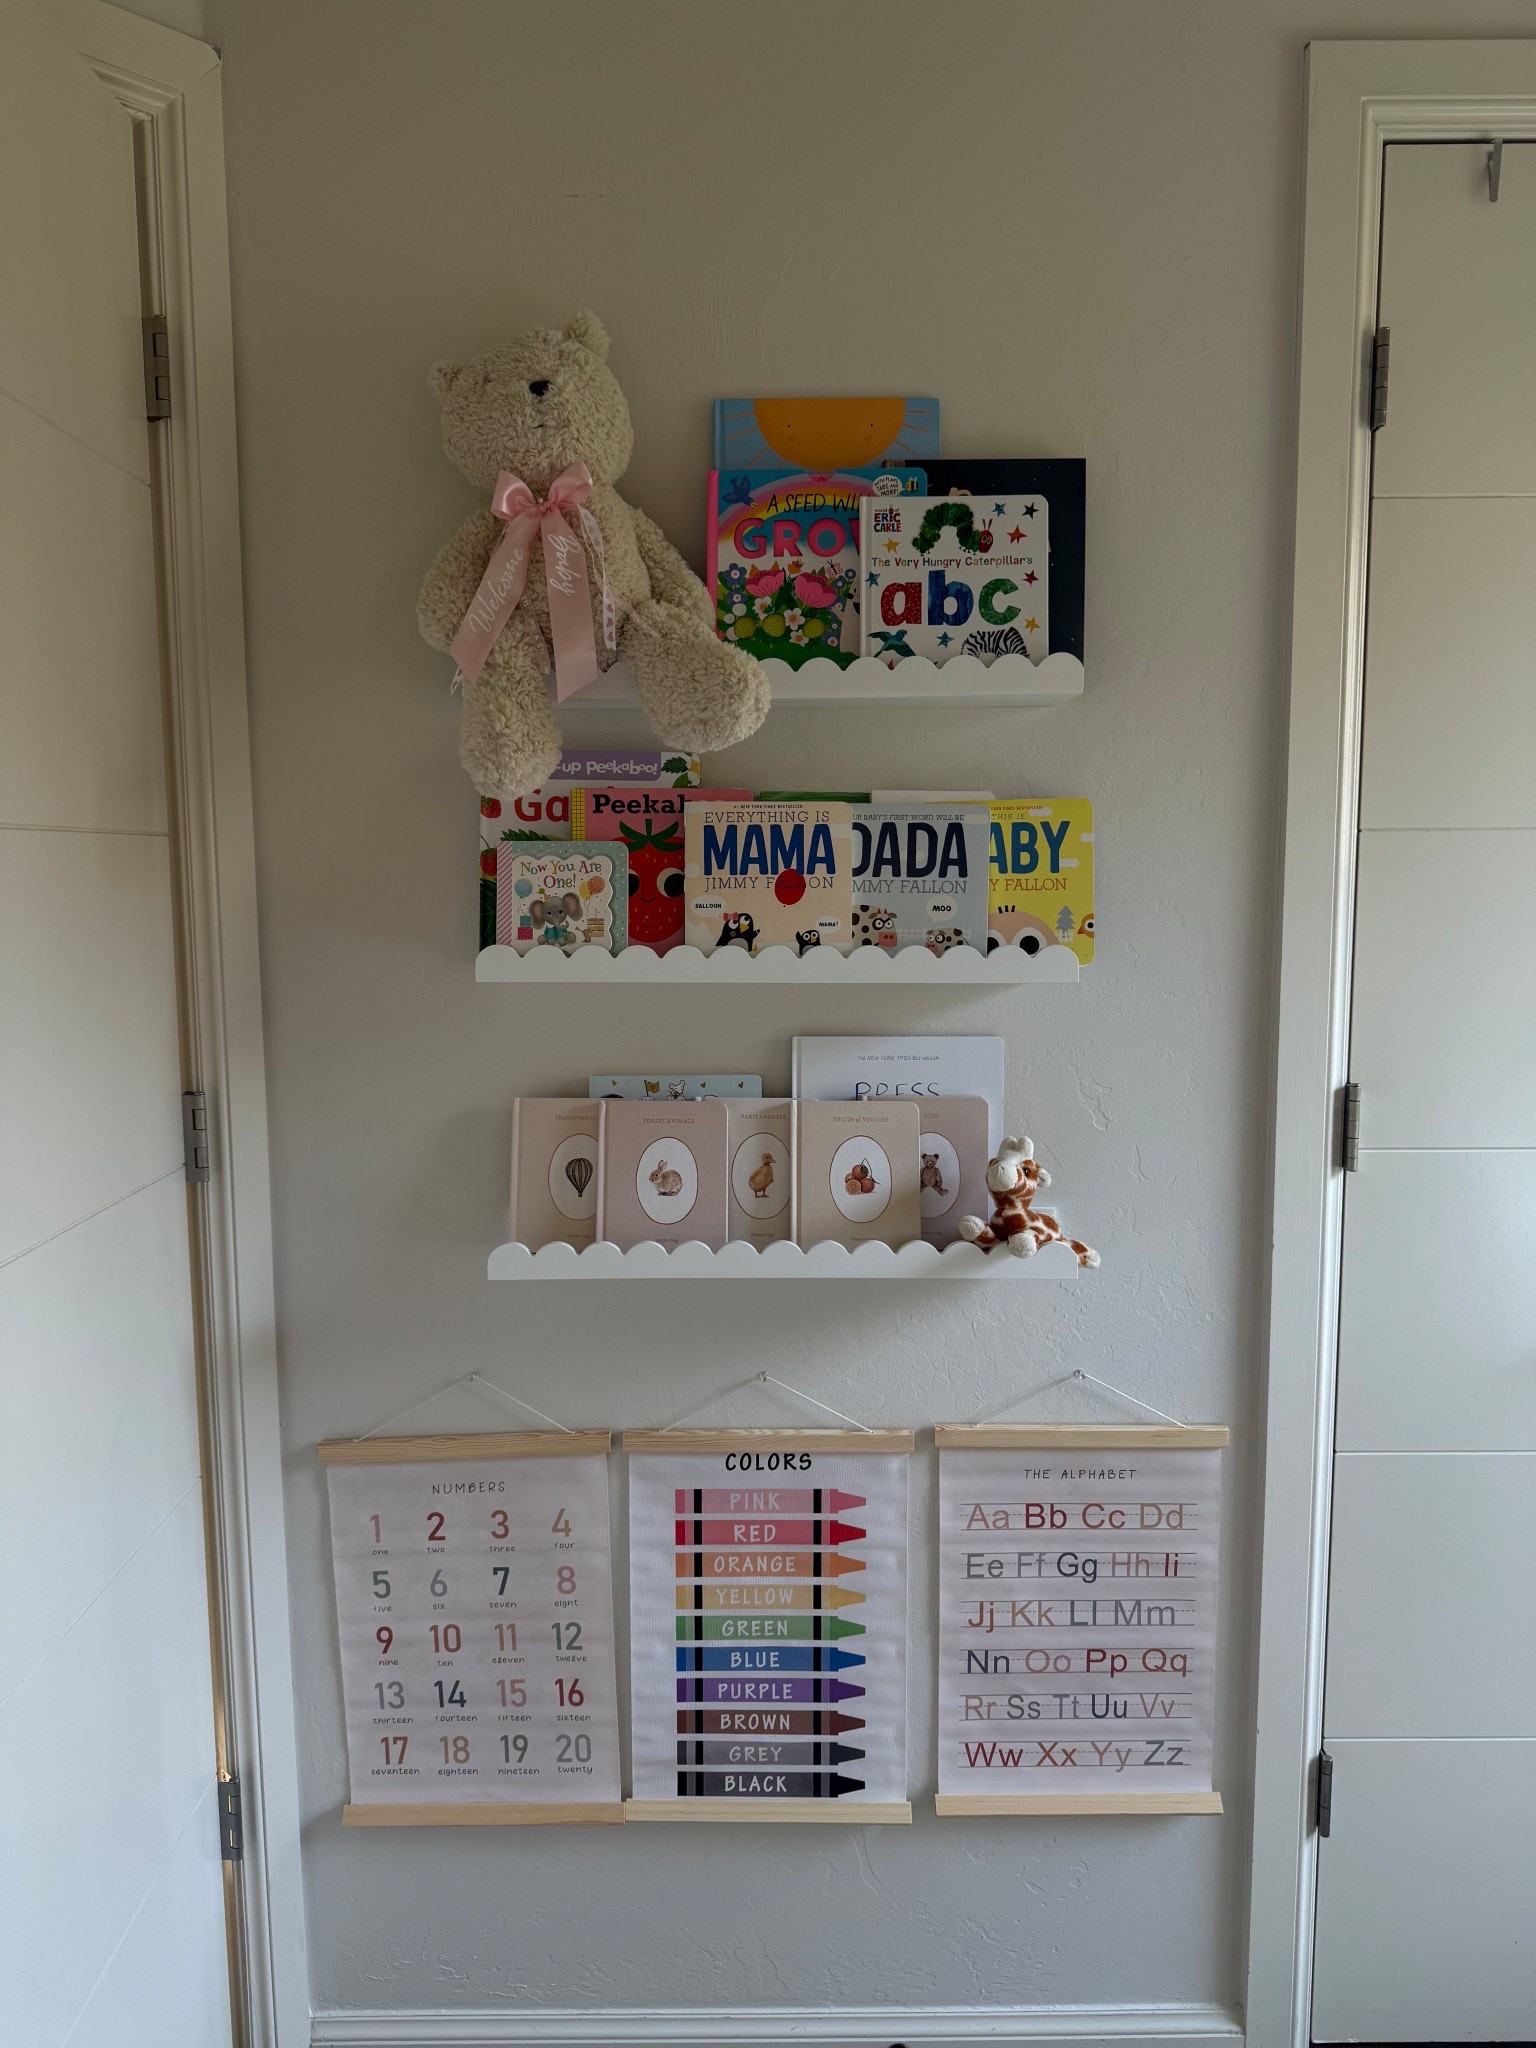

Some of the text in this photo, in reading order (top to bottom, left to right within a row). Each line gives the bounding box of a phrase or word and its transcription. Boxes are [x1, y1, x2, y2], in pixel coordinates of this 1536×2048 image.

[767, 493, 870, 513] A SEED WI
[873, 522, 902, 533] CARLE
[547, 534, 581, 597] Baby
[871, 555, 1033, 570] The Very Hungry Caterpillar's
[469, 548, 524, 634] Welcome
[880, 569, 1022, 626] abc
[586, 759, 658, 776] peekaboo!
[704, 810, 830, 823] EVERYTHING IS
[703, 824, 837, 876] MAMA
[852, 822, 968, 878] DADA
[989, 821, 1071, 874] ABY
[520, 860, 602, 876] Now You Are
[543, 873, 577, 888] One!
[705, 876, 834, 892] JIMMY FALLON
[852, 880, 967, 894] MMY FALLON
[1004, 878, 1067, 891] FALLON
[725, 1453, 813, 1471] COLORS
[1024, 1468, 1137, 1480] THE ALPHABET
[432, 1481, 506, 1495] NUMBERS
[729, 1493, 781, 1511] PINK
[370, 1508, 572, 1543] 1 2 3 4
[967, 1503, 1184, 1530] Aa Bb Cc Dd
[734, 1524, 776, 1543] RED
[372, 1548, 390, 1556] one
[427, 1546, 445, 1554] two
[714, 1555, 796, 1573] ORANGE
[966, 1552, 1179, 1583] Ee Ff Gg Hh Ii
[372, 1566, 577, 1599] 5 6 7 8
[489, 1600, 517, 1609] seven
[554, 1599, 579, 1608] eight
[716, 1588, 794, 1606] YELLOW
[967, 1600, 1176, 1633] Jj Kk Ll Mm
[376, 1622, 583, 1654] 9 10 11 12
[722, 1620, 788, 1638] GREEN
[437, 1659, 454, 1667] ten
[492, 1656, 525, 1664] eleven
[555, 1655, 588, 1663] twelve
[730, 1651, 780, 1669] BLUE
[966, 1648, 1188, 1677] Nn Oo Pp Qq
[374, 1678, 585, 1710] 13 14 15 16
[718, 1683, 793, 1700] PURPLE
[964, 1693, 1175, 1720] Rr Ss Tt Uu Vv
[373, 1714, 591, 1725] thirteen fourteen fifteen sixteen
[720, 1713, 791, 1731] BROWN
[380, 1734, 592, 1765] 17 18 19 20
[729, 1746, 783, 1763] GREY
[964, 1740, 1184, 1772] Ww Xx Yy Zz
[371, 1765, 592, 1777] seventeen eighteen nineteen twenty
[724, 1775, 787, 1793] BLACK
